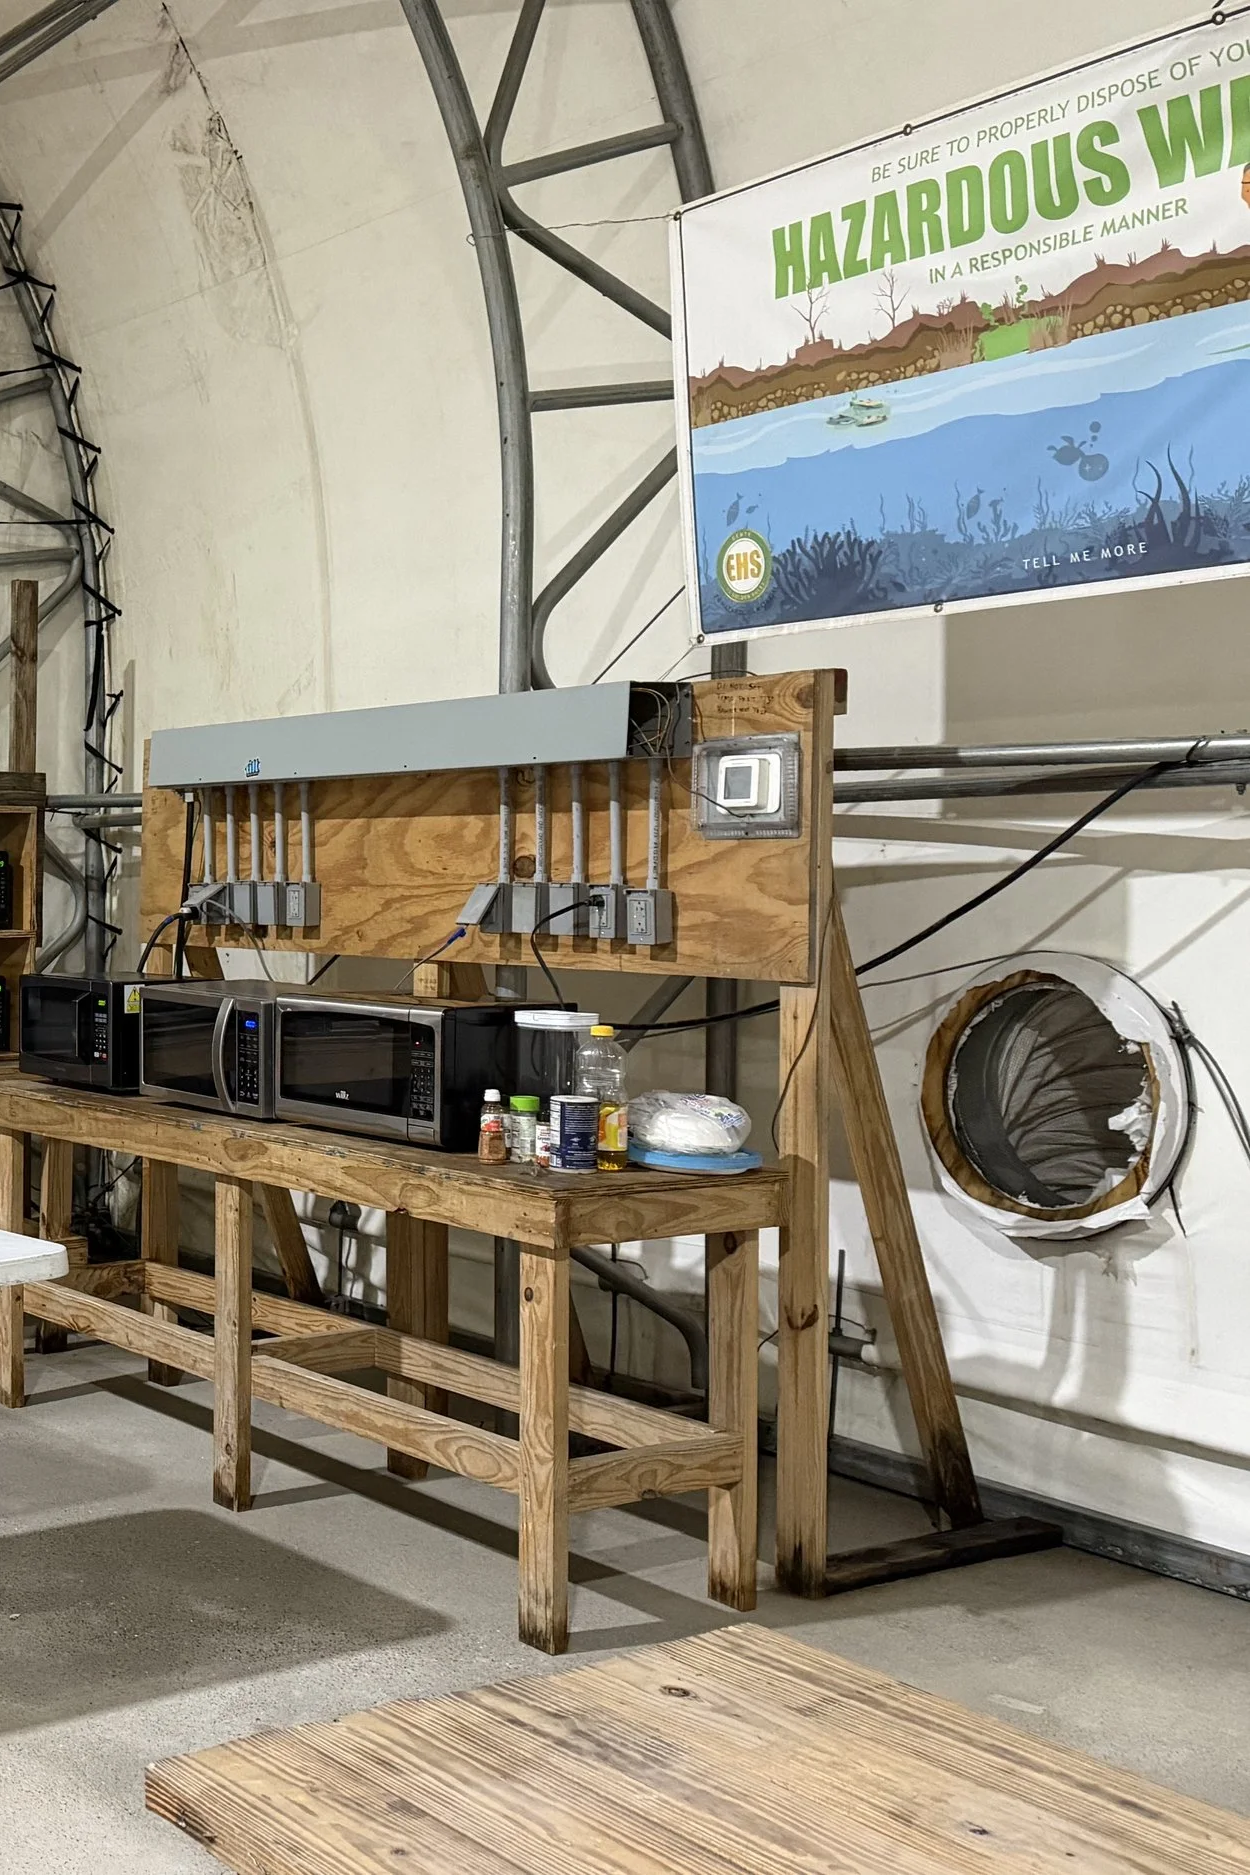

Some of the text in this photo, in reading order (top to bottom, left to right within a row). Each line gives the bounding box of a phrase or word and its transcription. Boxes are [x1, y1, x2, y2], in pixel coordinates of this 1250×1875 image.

[871, 162, 892, 183] BE
[897, 145, 941, 174] SURE
[946, 136, 970, 156] TO
[976, 99, 1070, 147] PROPERLY
[1076, 69, 1162, 113] DISPOSE
[1169, 54, 1202, 81] OF
[772, 120, 1131, 299] HAZARDOUS
[929, 198, 1189, 284] IN A RESPONSIBLE MANNER
[726, 549, 762, 582] EHS
[1022, 542, 1148, 570] TELL ME MORE
